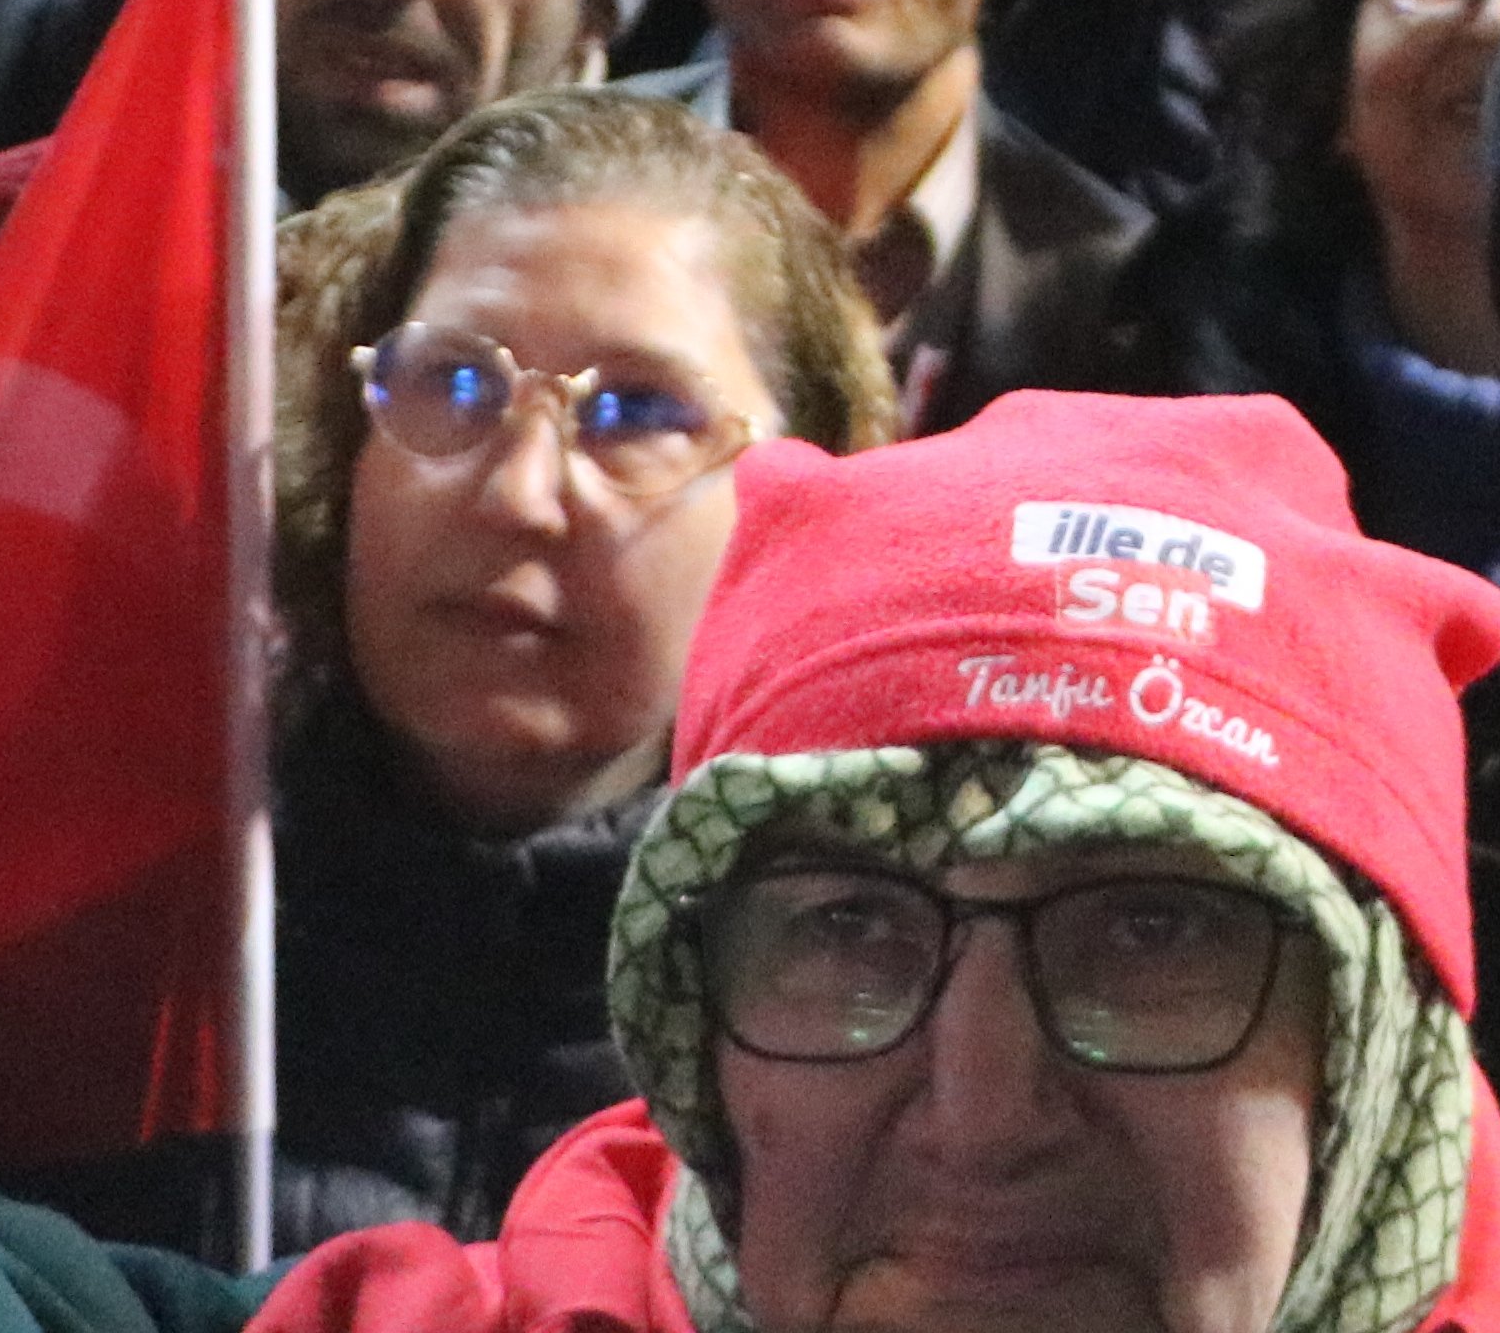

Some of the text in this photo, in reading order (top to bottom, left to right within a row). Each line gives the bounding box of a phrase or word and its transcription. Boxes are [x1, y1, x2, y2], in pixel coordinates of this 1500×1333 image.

[1047, 509, 1237, 587] ille de
[1060, 567, 1211, 636] Sen
[957, 652, 1281, 767] Tanju Özcan
